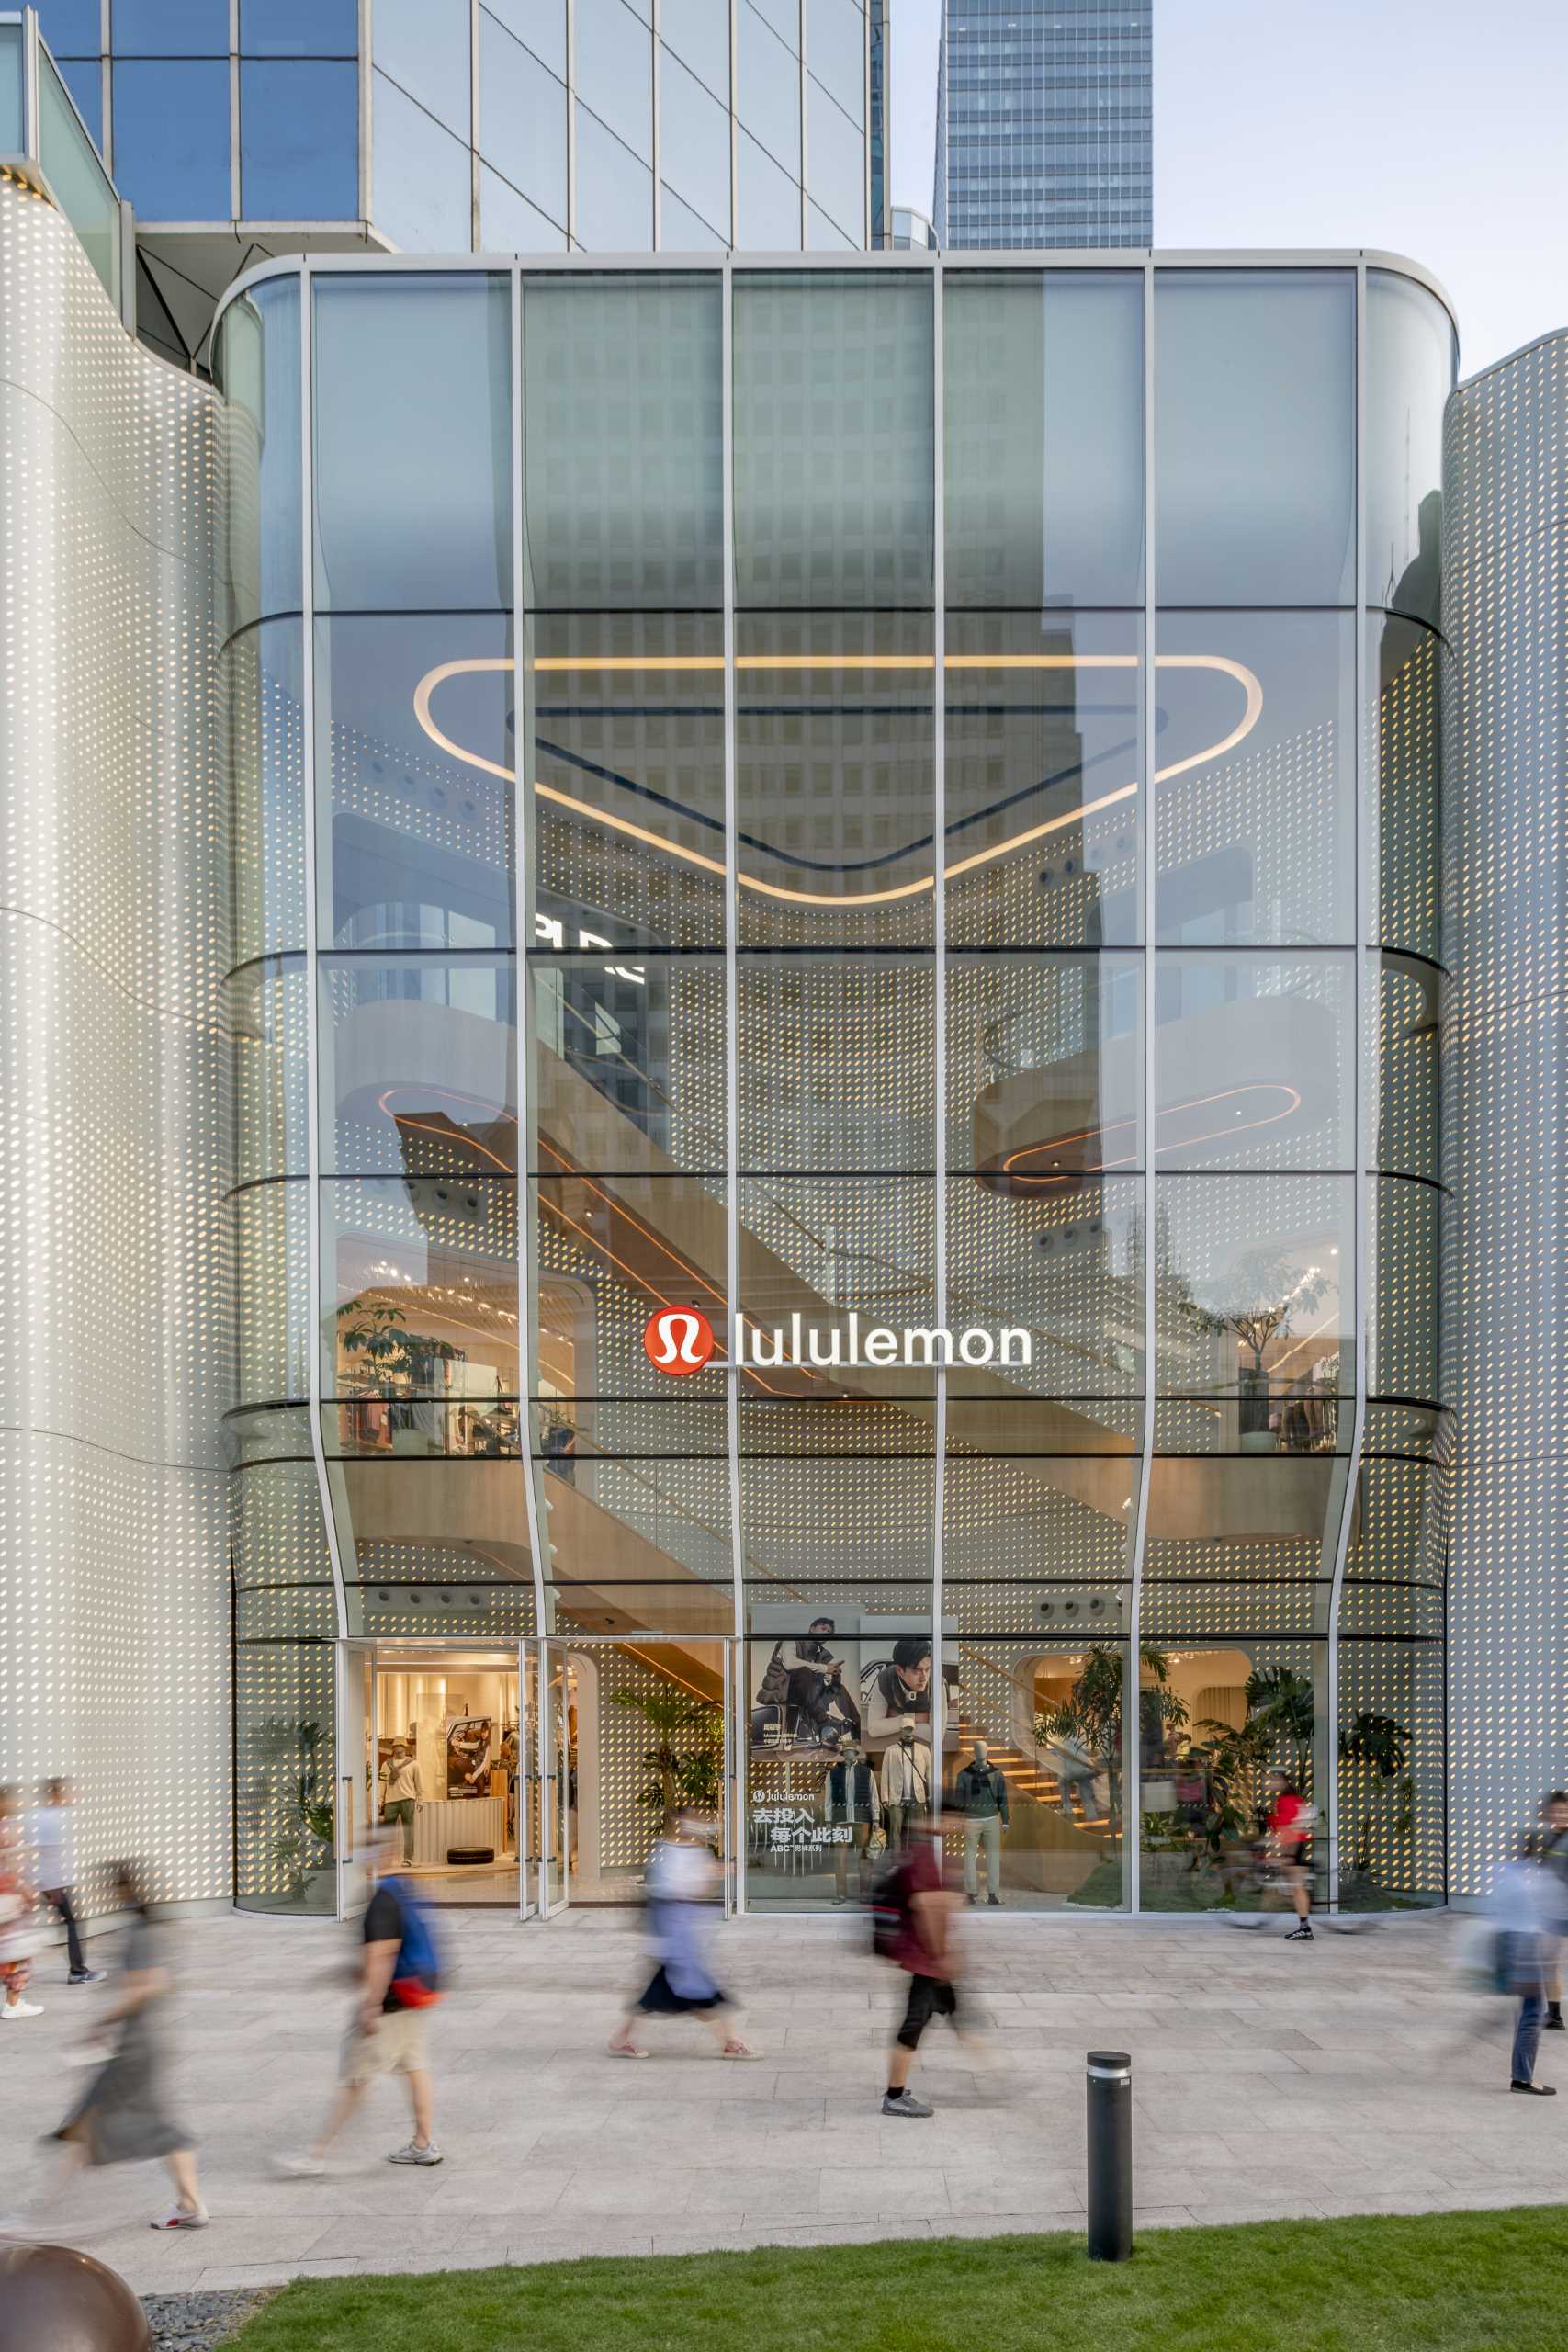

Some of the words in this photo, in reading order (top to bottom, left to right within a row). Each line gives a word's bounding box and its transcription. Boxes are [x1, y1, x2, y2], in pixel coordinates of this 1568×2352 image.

[735, 1312, 1032, 1366] lululemon
[768, 1792, 815, 1802] lululemon
[752, 1807, 815, 1824] 去投入
[770, 1826, 852, 1843] 每个此刻
